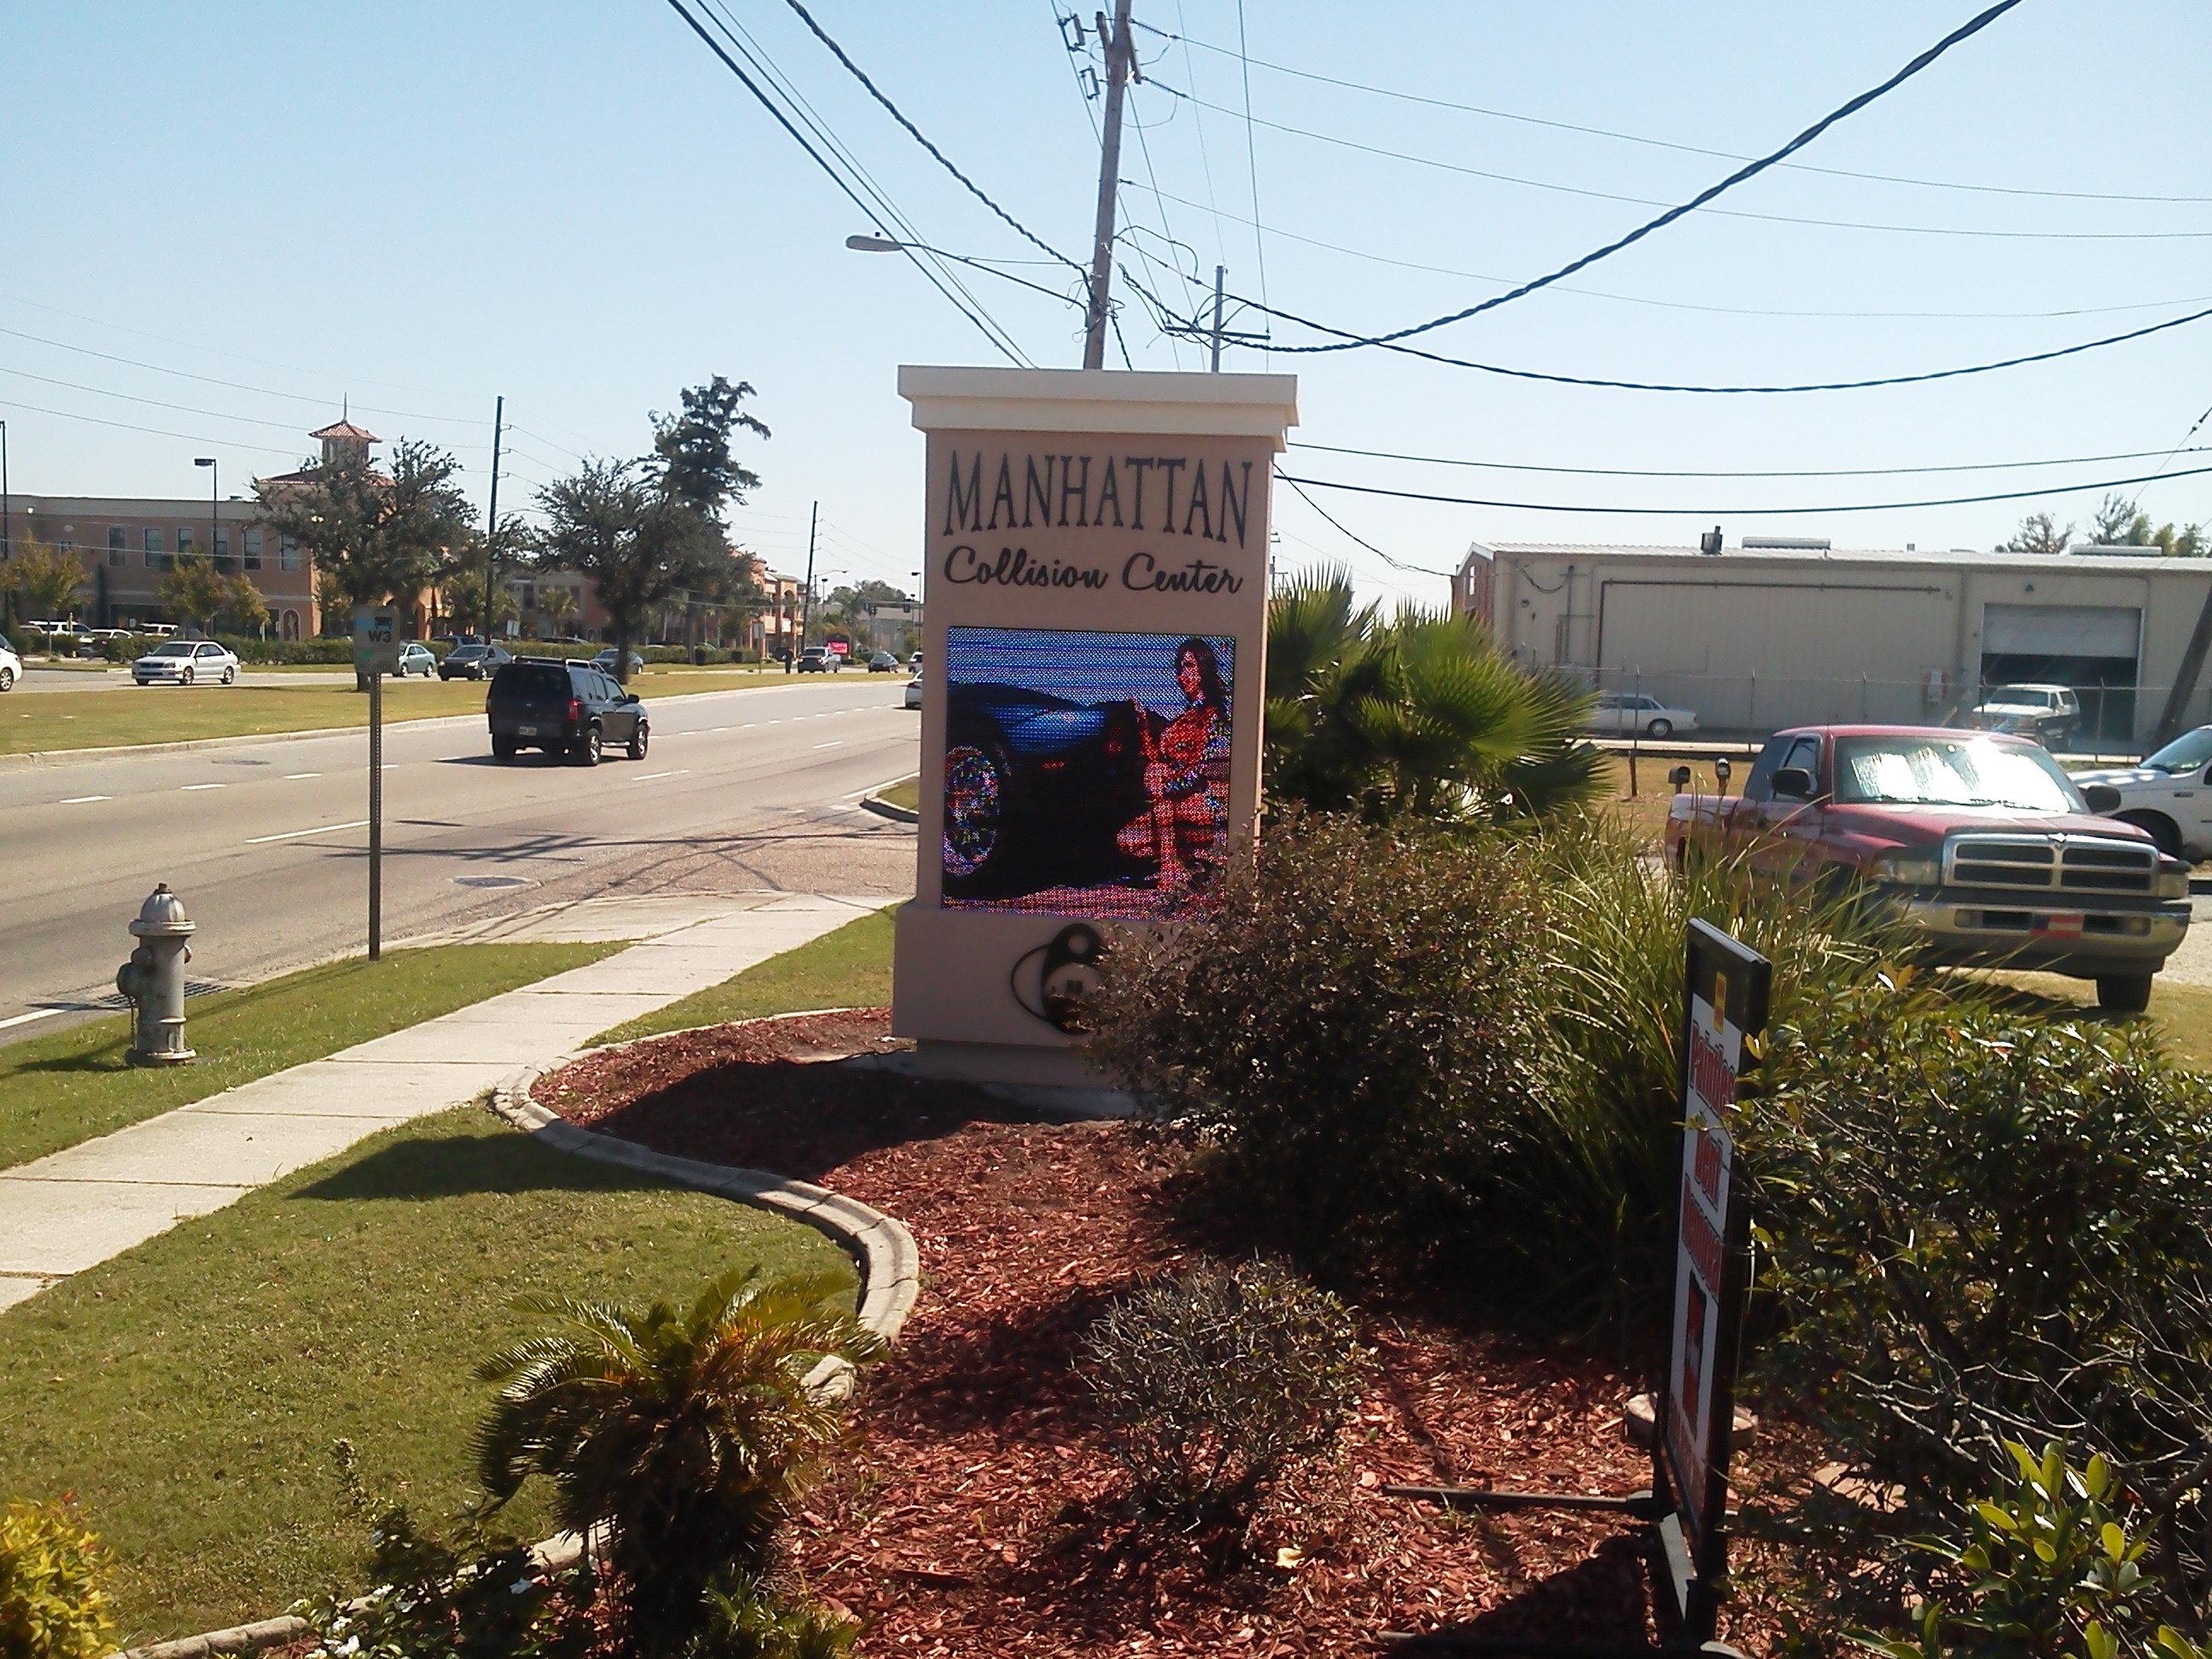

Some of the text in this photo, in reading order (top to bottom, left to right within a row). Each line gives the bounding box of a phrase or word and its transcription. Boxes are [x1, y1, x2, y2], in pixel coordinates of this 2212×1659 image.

[943, 450, 1253, 550] MANHATTAN
[944, 545, 1243, 594] Collision Center
[368, 631, 392, 643] W3
